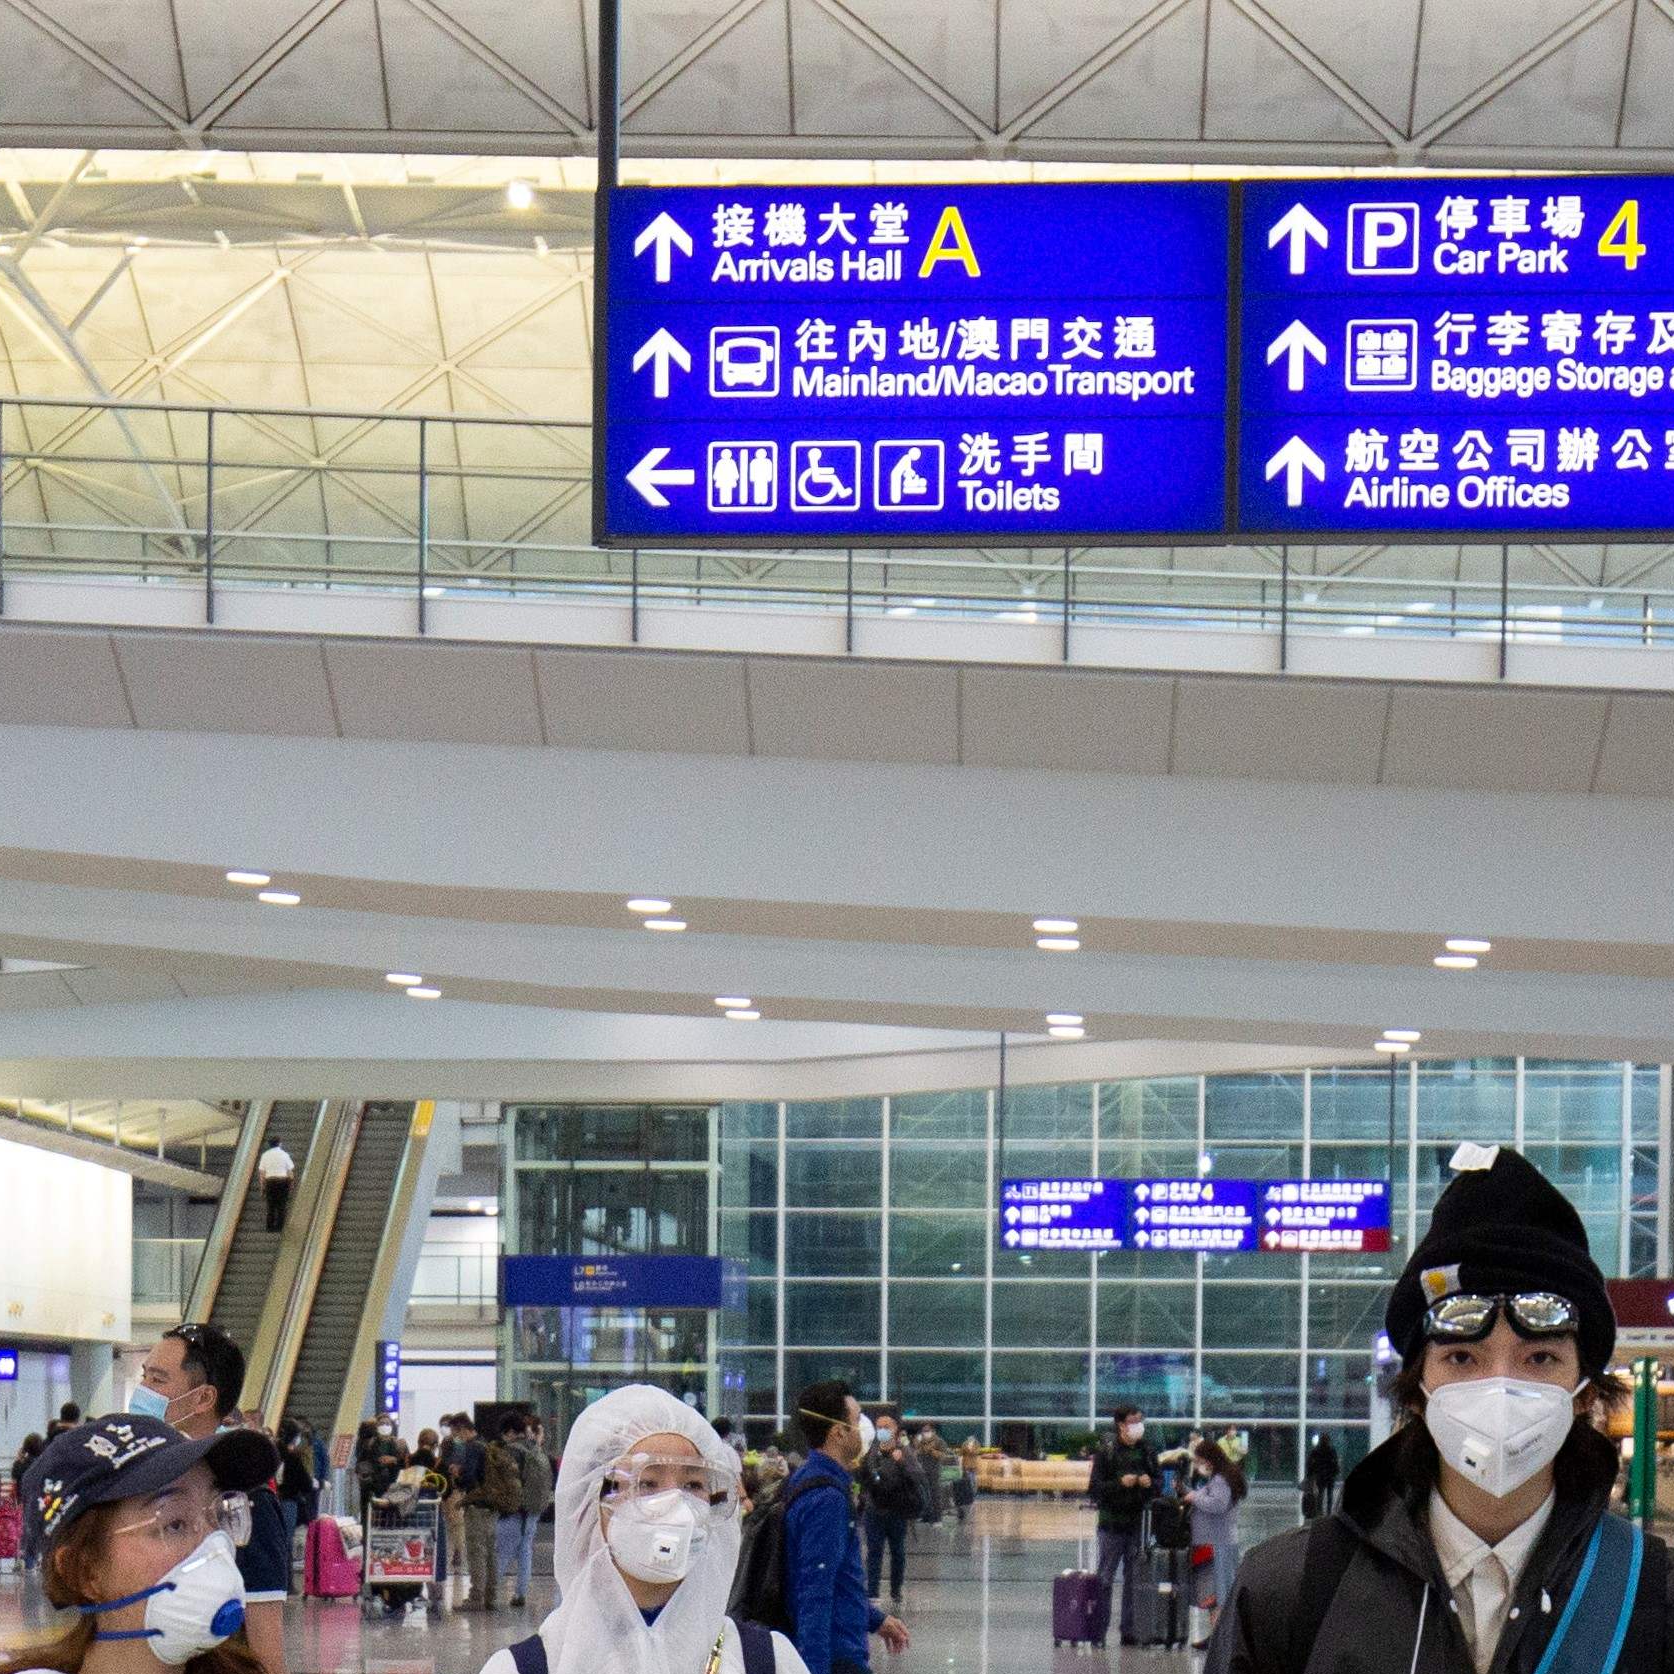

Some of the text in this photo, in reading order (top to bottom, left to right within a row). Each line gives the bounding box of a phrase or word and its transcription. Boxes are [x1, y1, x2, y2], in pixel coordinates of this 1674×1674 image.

[712, 202, 909, 247] 接機大堂
[1435, 195, 1585, 240] 停車場
[1598, 200, 1646, 270] 4
[919, 207, 981, 277] A
[1364, 212, 1408, 268] P
[1434, 241, 1568, 274] Car Park
[712, 250, 901, 282] Arrivals Hall
[793, 364, 1194, 401] Mainland/Macao Transport
[1431, 360, 1551, 398] Baggage
[1557, 358, 1664, 397] Storage
[959, 432, 1103, 476] 洗手間
[958, 480, 1060, 511] Toilets
[1344, 476, 1569, 508] Airline Offices
